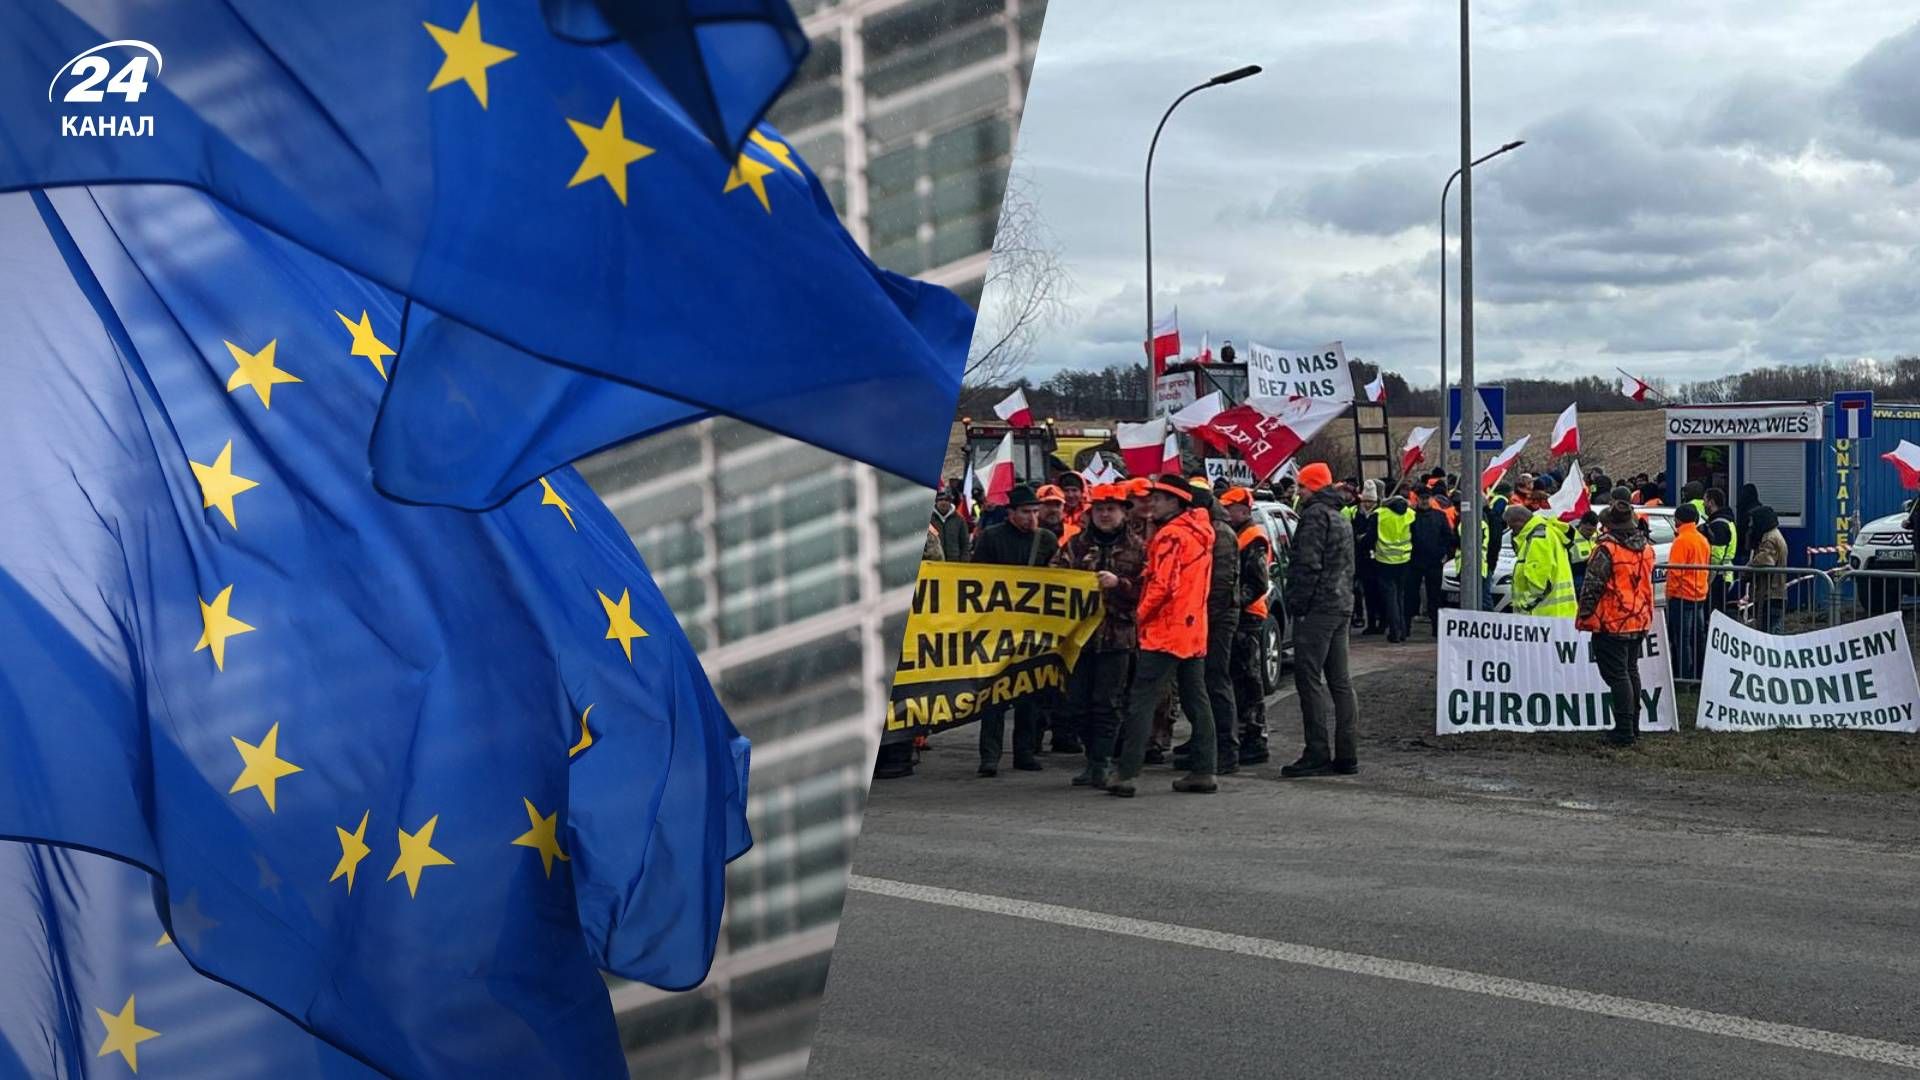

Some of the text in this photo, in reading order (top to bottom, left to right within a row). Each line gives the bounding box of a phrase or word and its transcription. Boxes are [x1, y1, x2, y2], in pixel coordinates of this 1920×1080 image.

[1278, 357, 1291, 374] O
[1297, 351, 1339, 374] NAS
[1258, 376, 1336, 398] BEZ NAS
[1669, 411, 1809, 435] OSZUKANA WIEŚ
[957, 580, 1100, 621] RAZEM
[1447, 619, 1550, 643] PRACUJEMY
[1555, 641, 1577, 663] W
[1711, 627, 1898, 669] GOSPODARUJEMY
[1467, 660, 1511, 683] I GO
[1729, 667, 1878, 705] ZGODNIE
[1705, 701, 1913, 728] Z PRAWAMI PRZYRODY
